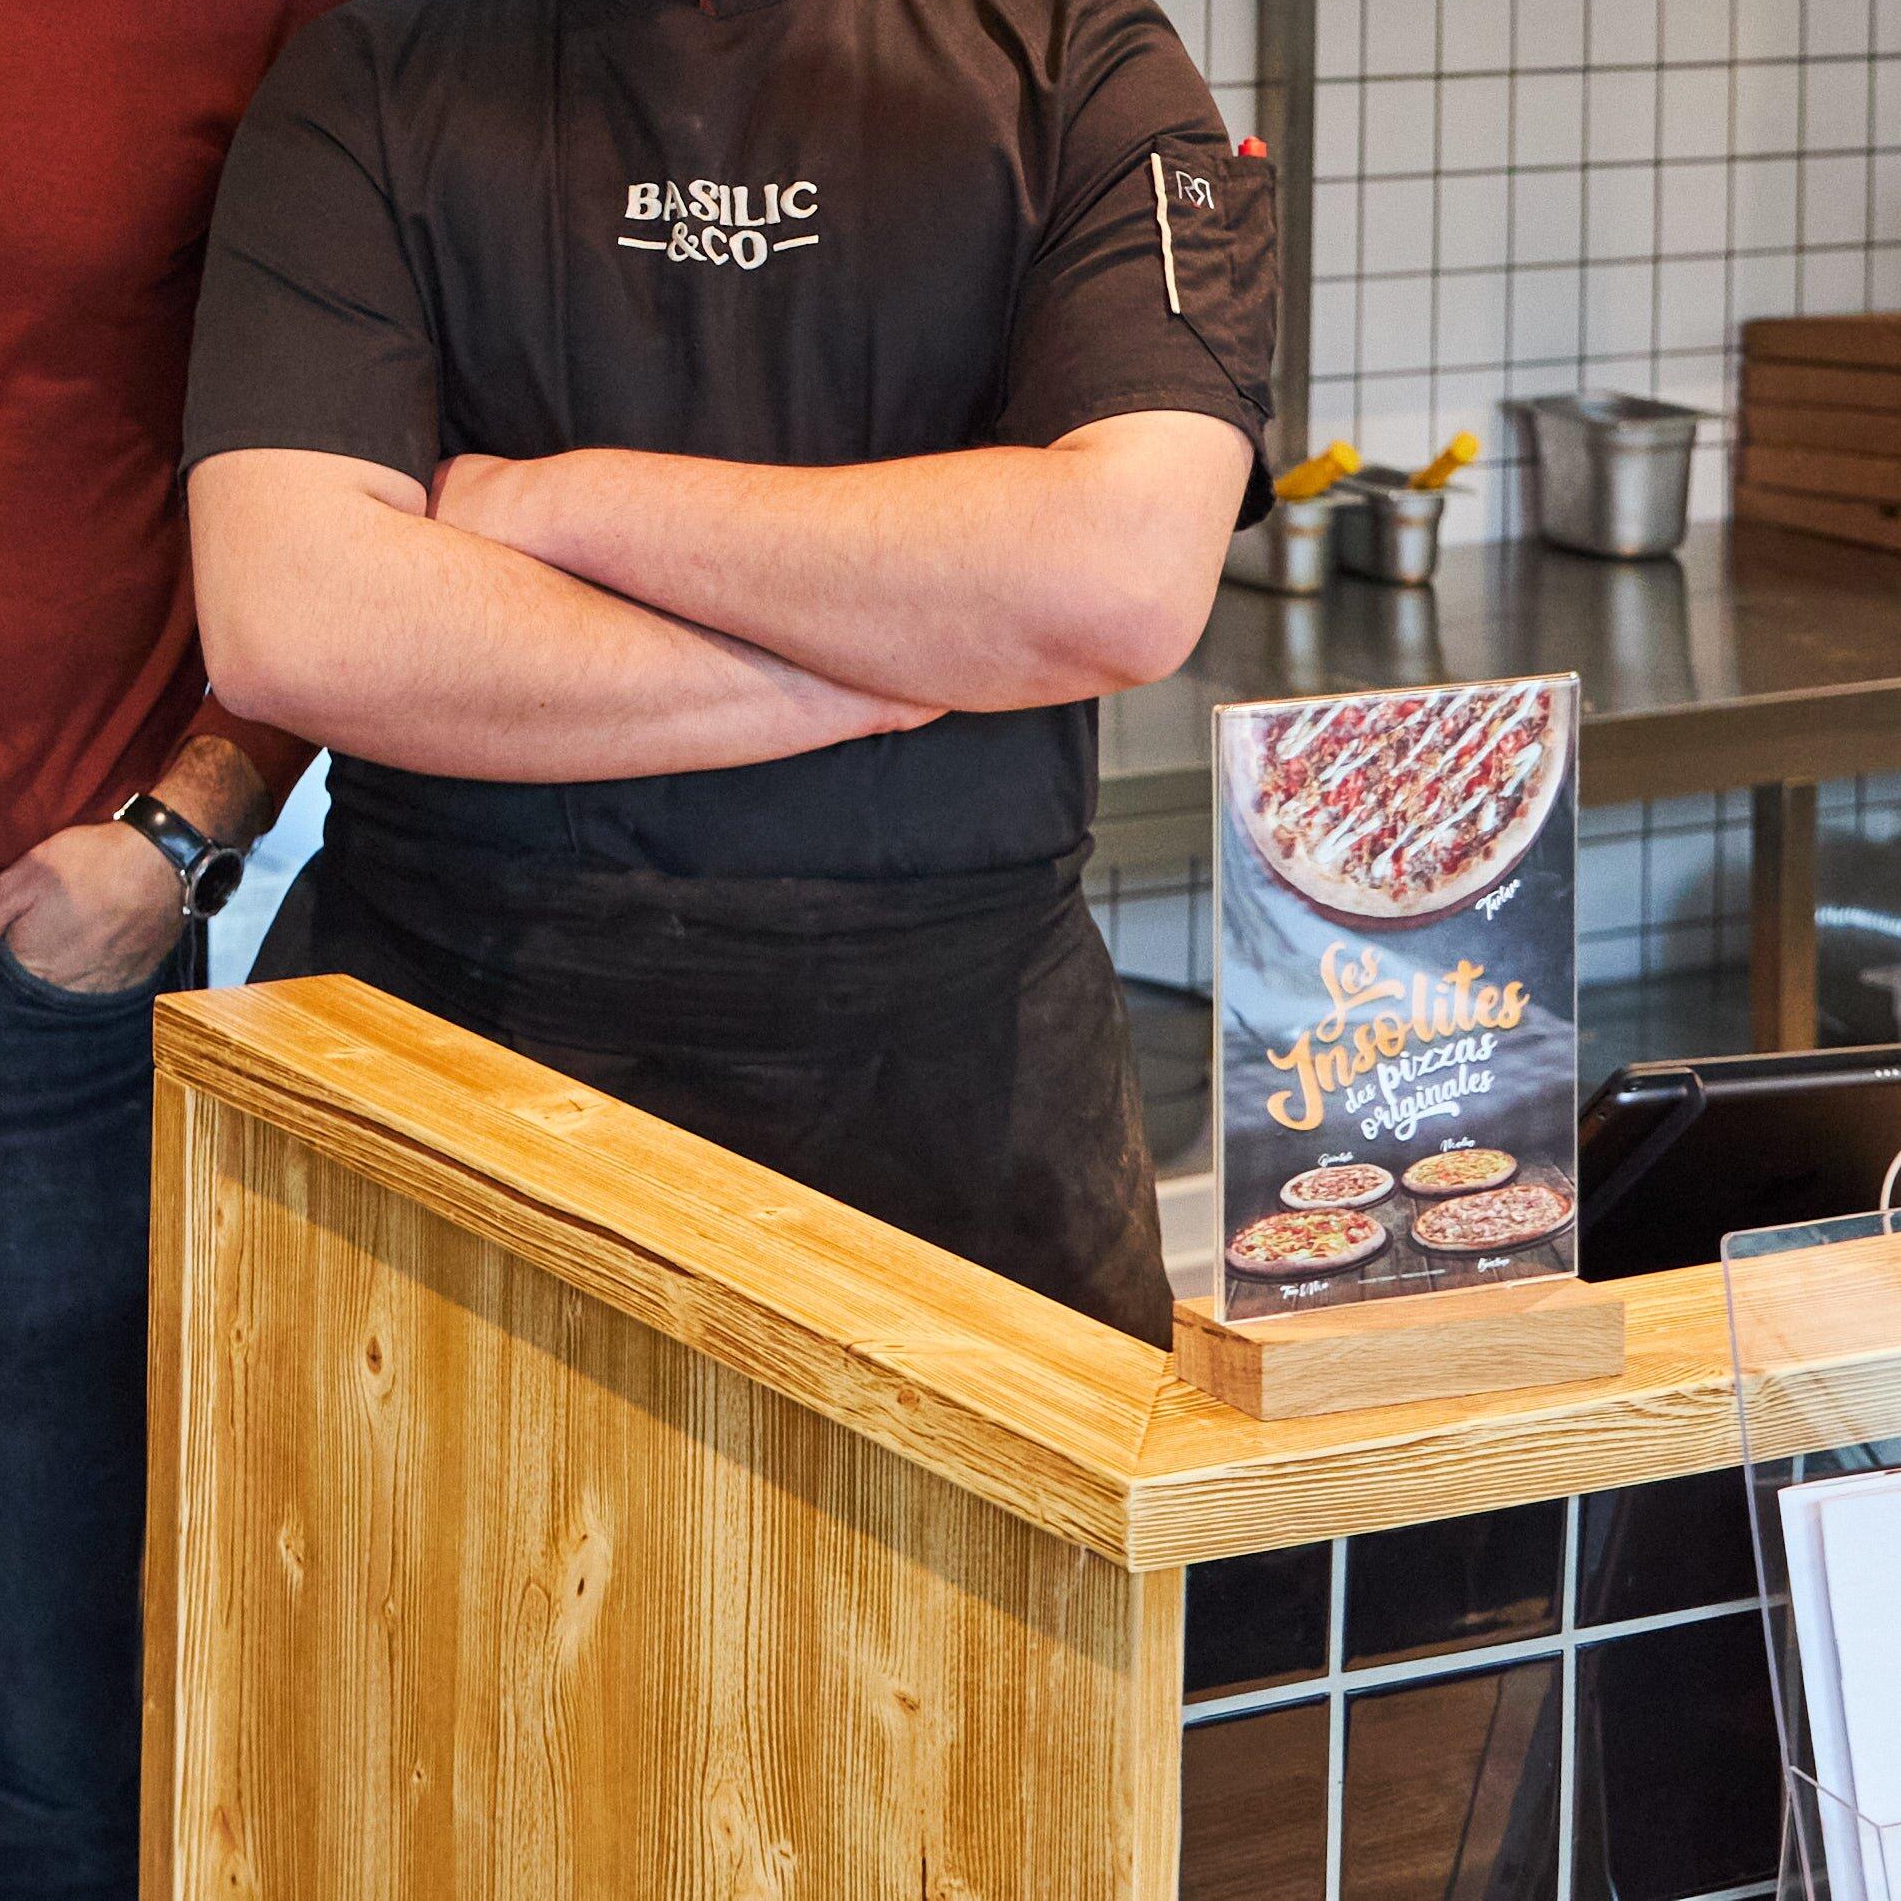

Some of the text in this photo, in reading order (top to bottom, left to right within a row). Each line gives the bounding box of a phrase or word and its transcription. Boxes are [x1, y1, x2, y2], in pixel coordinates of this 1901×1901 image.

[624, 179, 819, 226] BASILIC
[1316, 941, 1406, 1043] Les
[1266, 958, 1531, 1132] Insolites
[1345, 1032, 1499, 1115] des pizzas
[1360, 1063, 1496, 1142] originales
